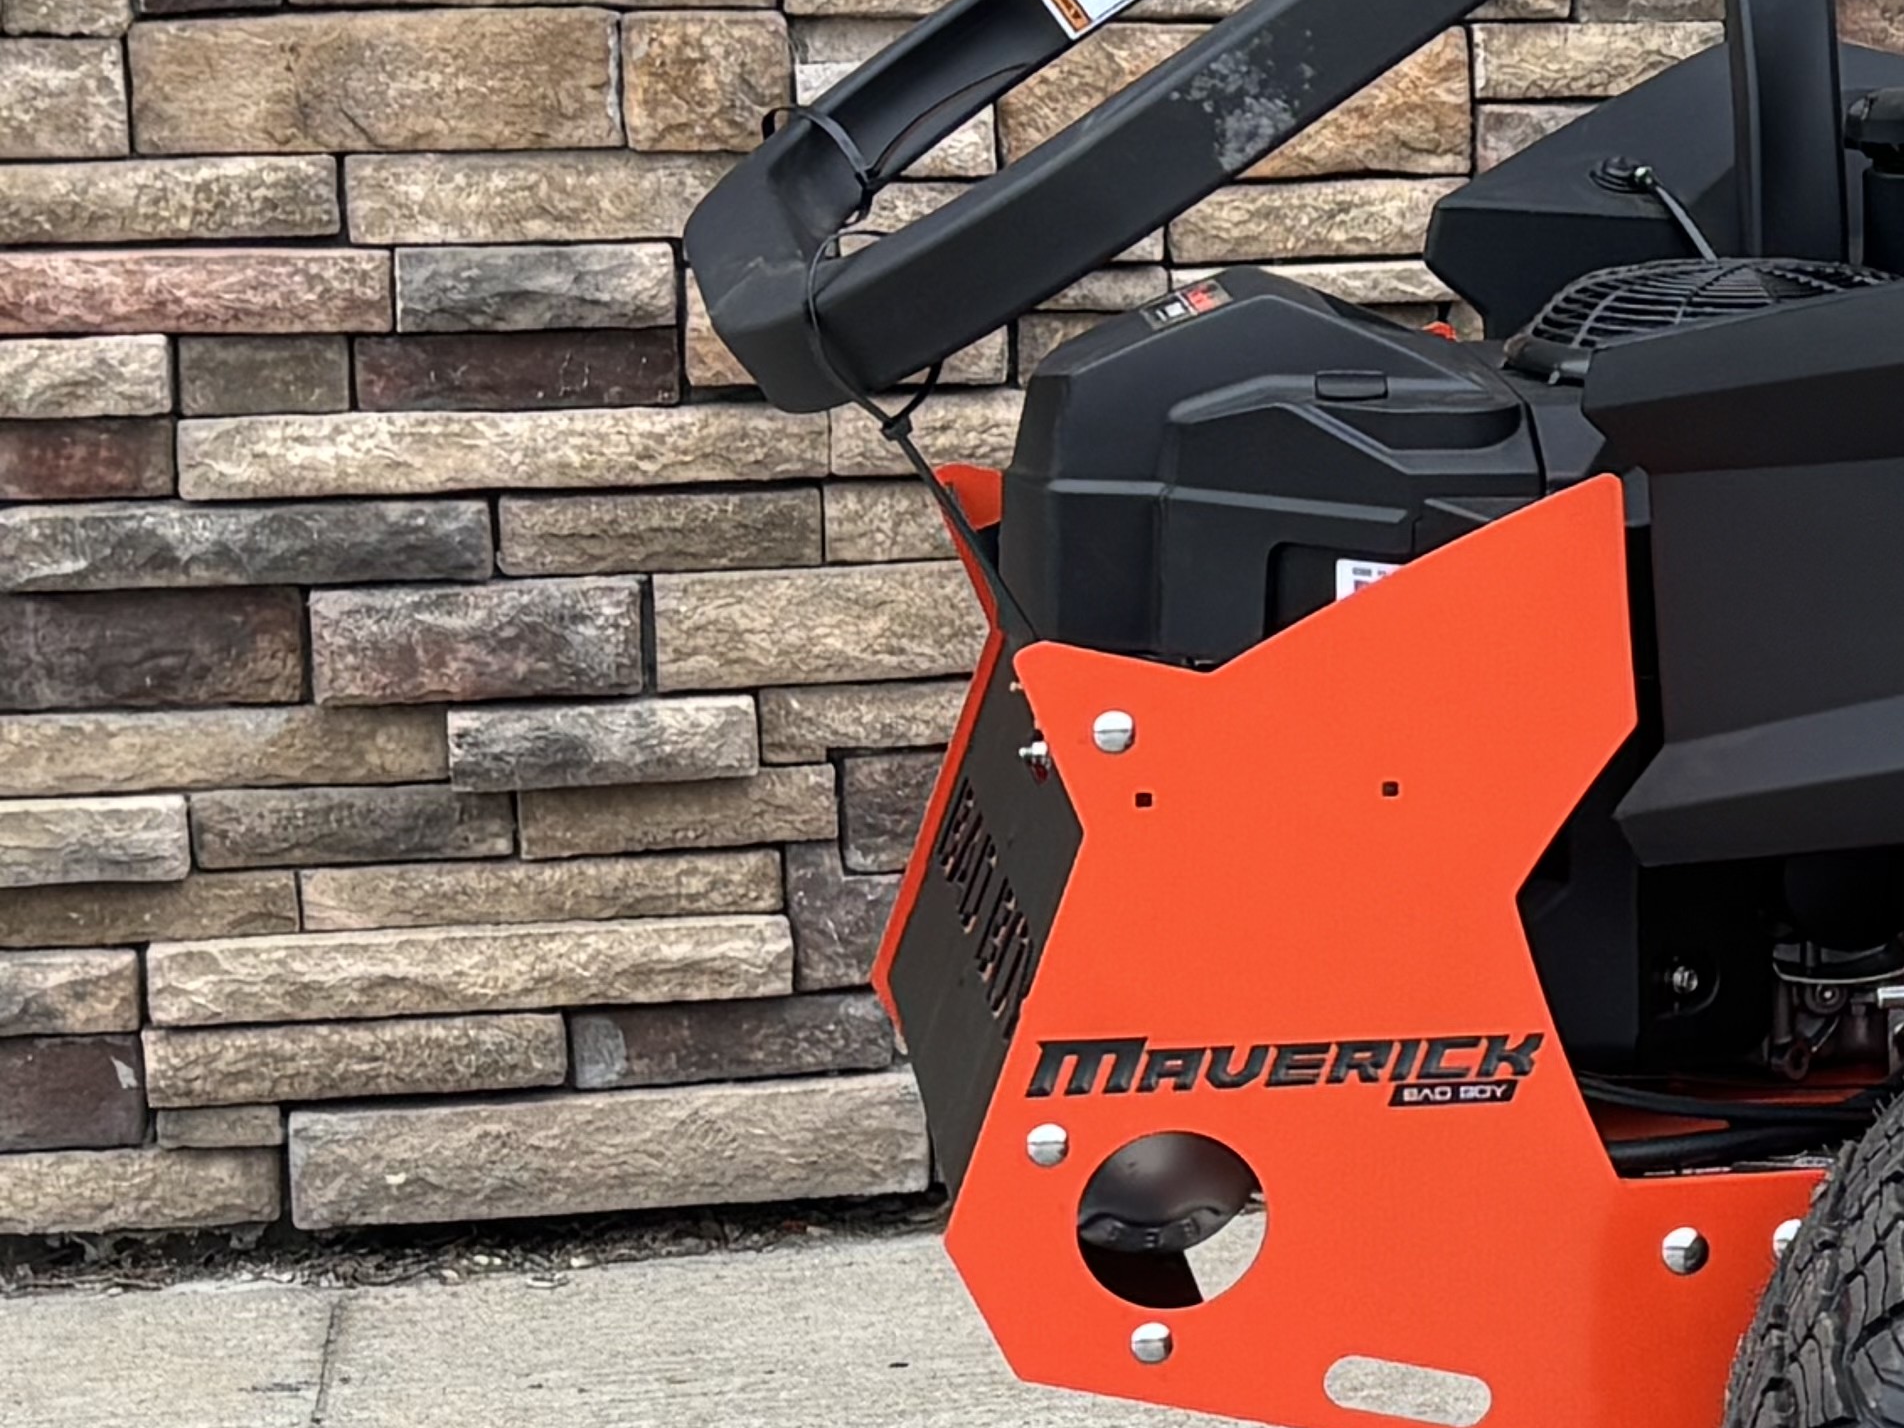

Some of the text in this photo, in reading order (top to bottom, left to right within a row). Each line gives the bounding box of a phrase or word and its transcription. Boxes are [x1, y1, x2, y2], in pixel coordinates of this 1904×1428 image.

[937, 776, 998, 934] BAD
[1403, 1083, 1508, 1103] BAD BOY
